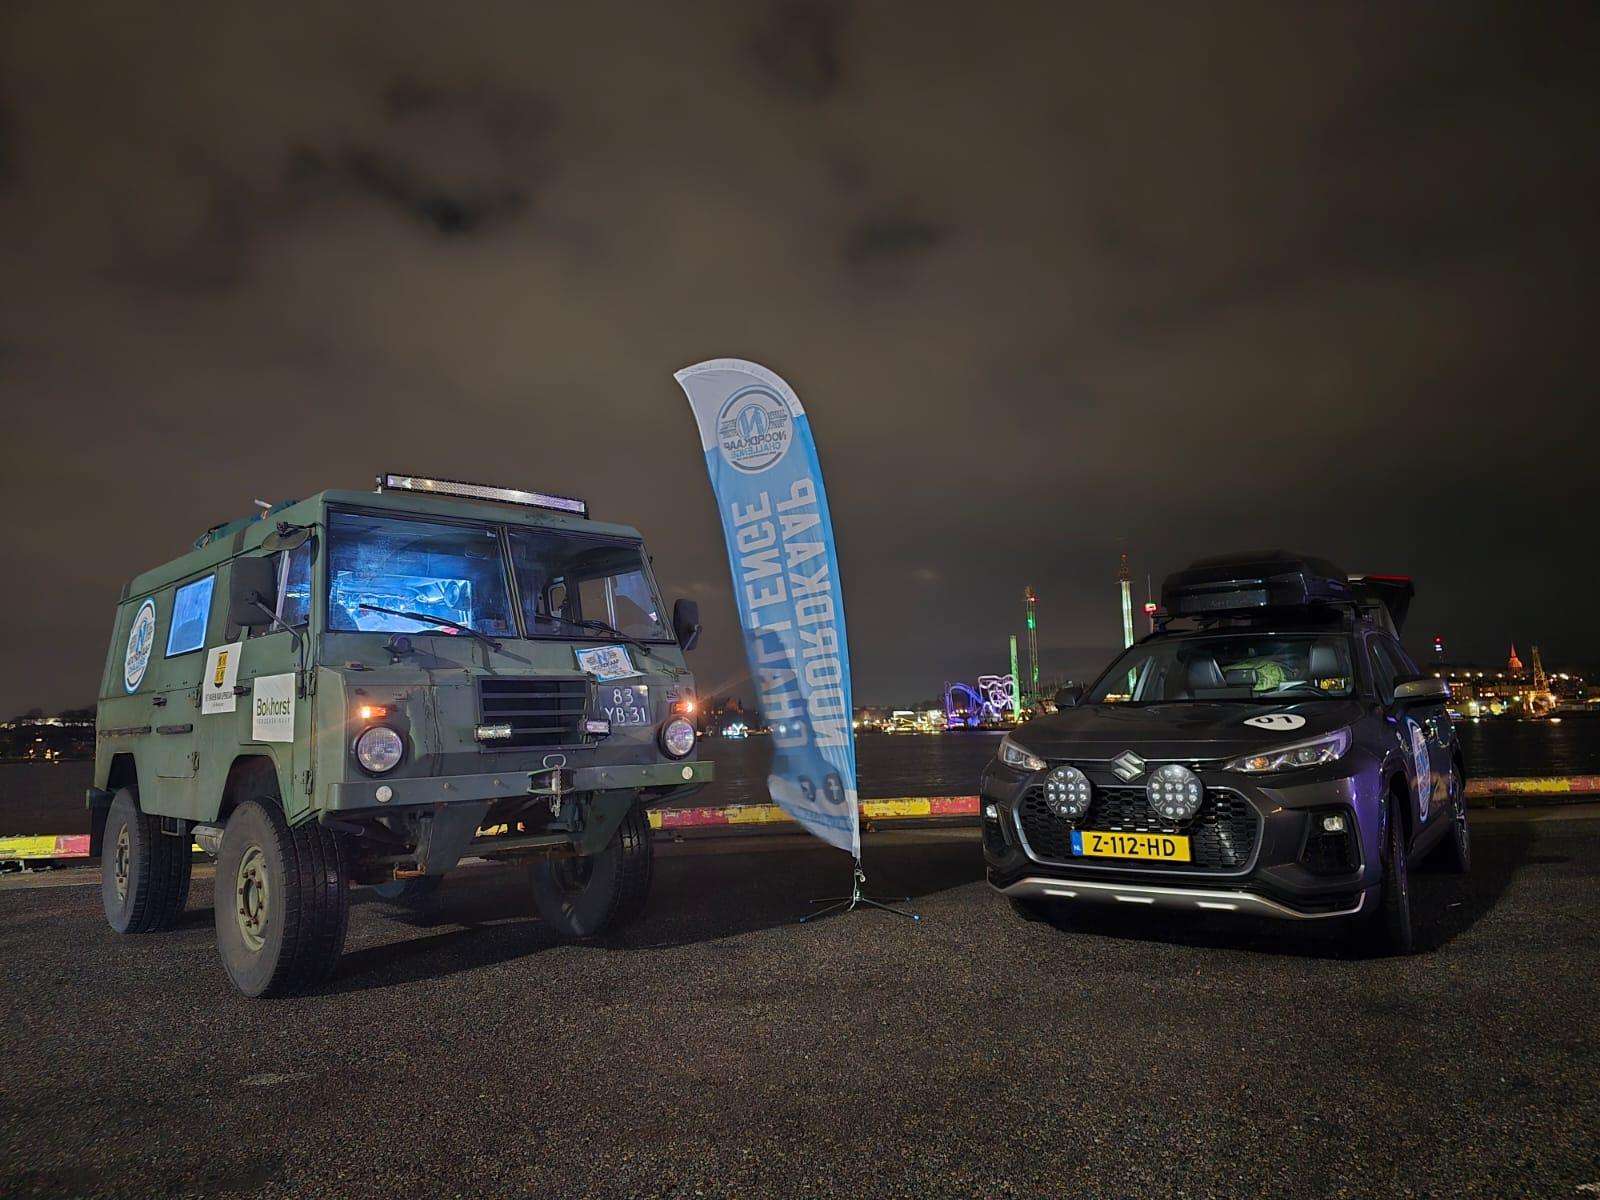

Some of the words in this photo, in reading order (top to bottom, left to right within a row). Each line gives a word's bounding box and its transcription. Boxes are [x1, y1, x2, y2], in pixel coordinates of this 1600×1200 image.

[613, 688, 634, 705] 83
[604, 706, 647, 724] YB-31
[1092, 835, 1176, 857] Z-112-HD
